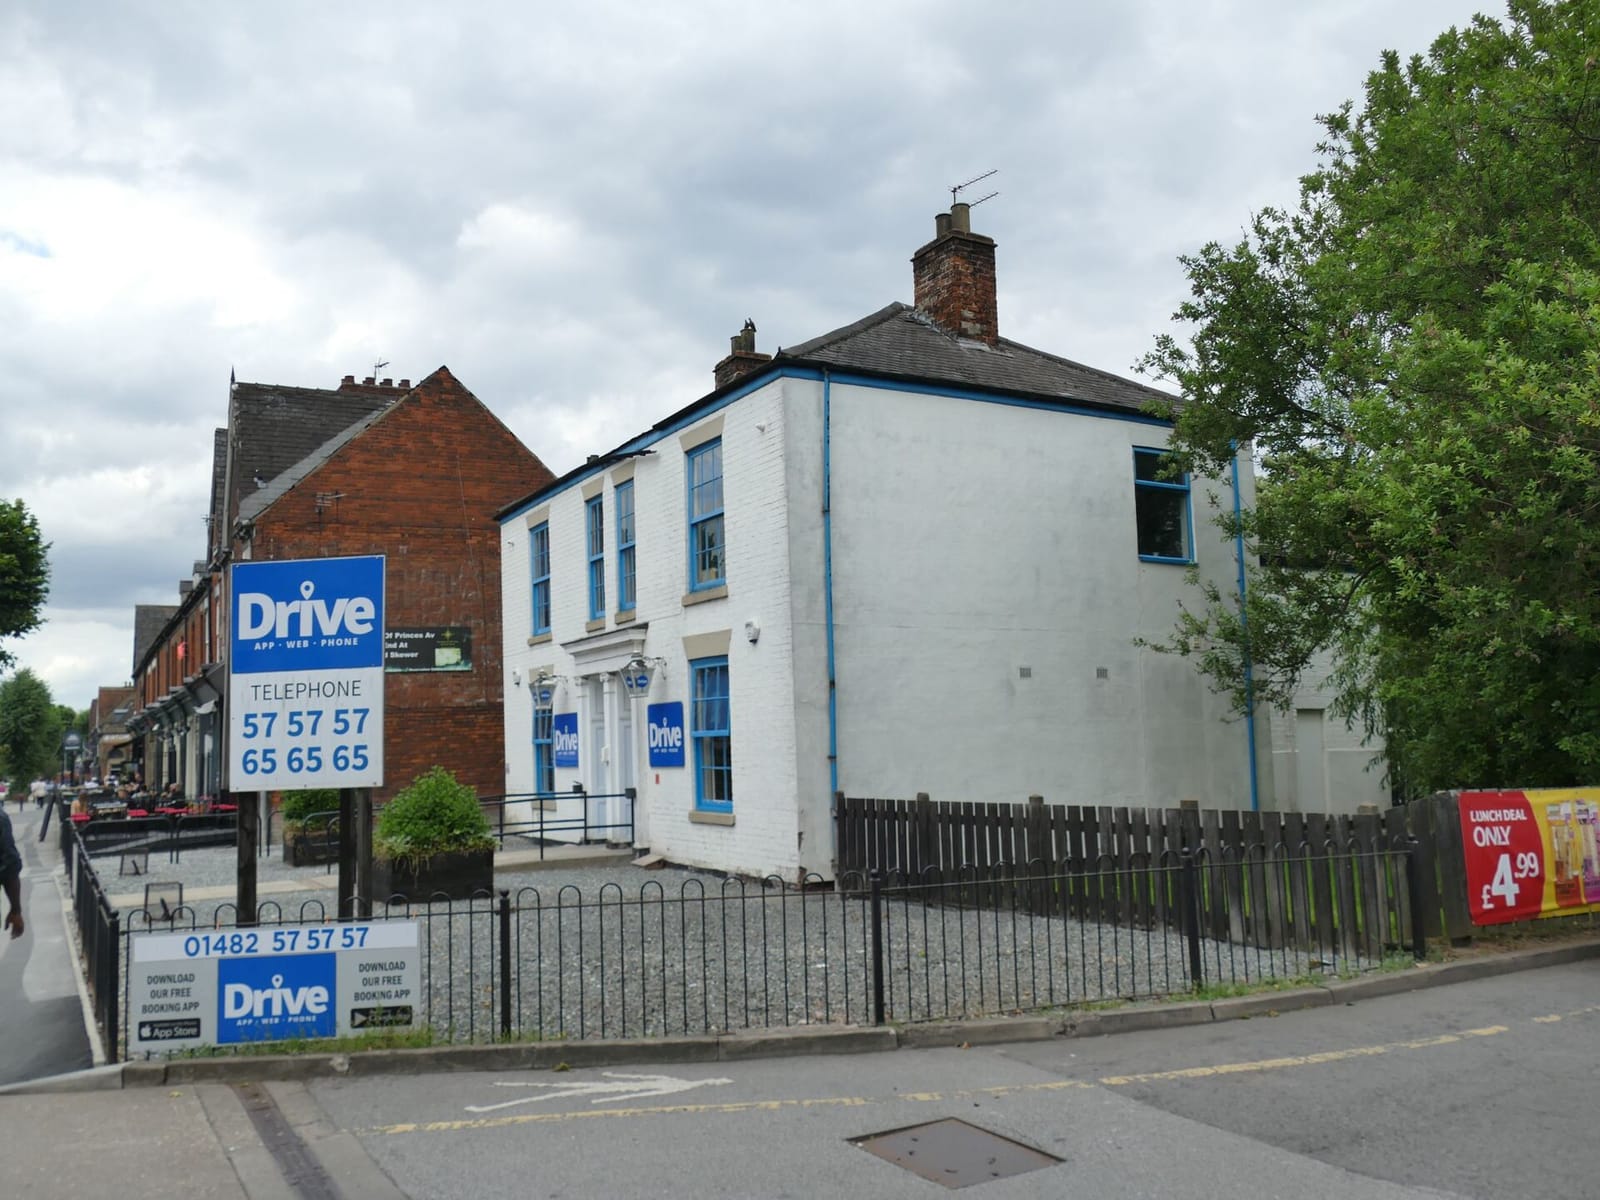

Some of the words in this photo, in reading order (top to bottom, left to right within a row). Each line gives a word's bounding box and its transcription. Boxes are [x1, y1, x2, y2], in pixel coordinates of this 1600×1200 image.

[238, 580, 375, 640] Drive
[254, 640, 275, 651] APP
[286, 639, 310, 649] WEB
[321, 637, 359, 647] PHONE
[251, 680, 362, 701] TELEPHONE
[242, 712, 278, 739] 57
[287, 710, 324, 737] 57
[333, 708, 370, 735] 57
[555, 725, 578, 751] Drive
[649, 717, 682, 748] Drive
[242, 748, 277, 775] 65
[287, 746, 323, 773] 65
[333, 744, 369, 771] 65
[1470, 809, 1502, 822] LUNCH
[1503, 808, 1528, 821] DEAL
[1473, 825, 1511, 847] ONLY
[184, 933, 258, 957] 01482
[273, 930, 300, 951] 57
[307, 929, 334, 950] 57
[341, 927, 369, 948] 57
[359, 961, 406, 972] DOWNLOAD
[147, 973, 195, 985] DOWNLOAD
[362, 976, 380, 986] OUR
[382, 975, 402, 985] FREE
[150, 989, 168, 999] OUR
[170, 987, 191, 998] FREE
[224, 974, 329, 1019] Drive
[354, 990, 392, 1001] BOOKING
[394, 989, 411, 999] APP
[142, 1002, 181, 1014] BOOKING
[182, 1001, 200, 1011] APP
[152, 1028, 172, 1040] App
[174, 1026, 198, 1037] Store
